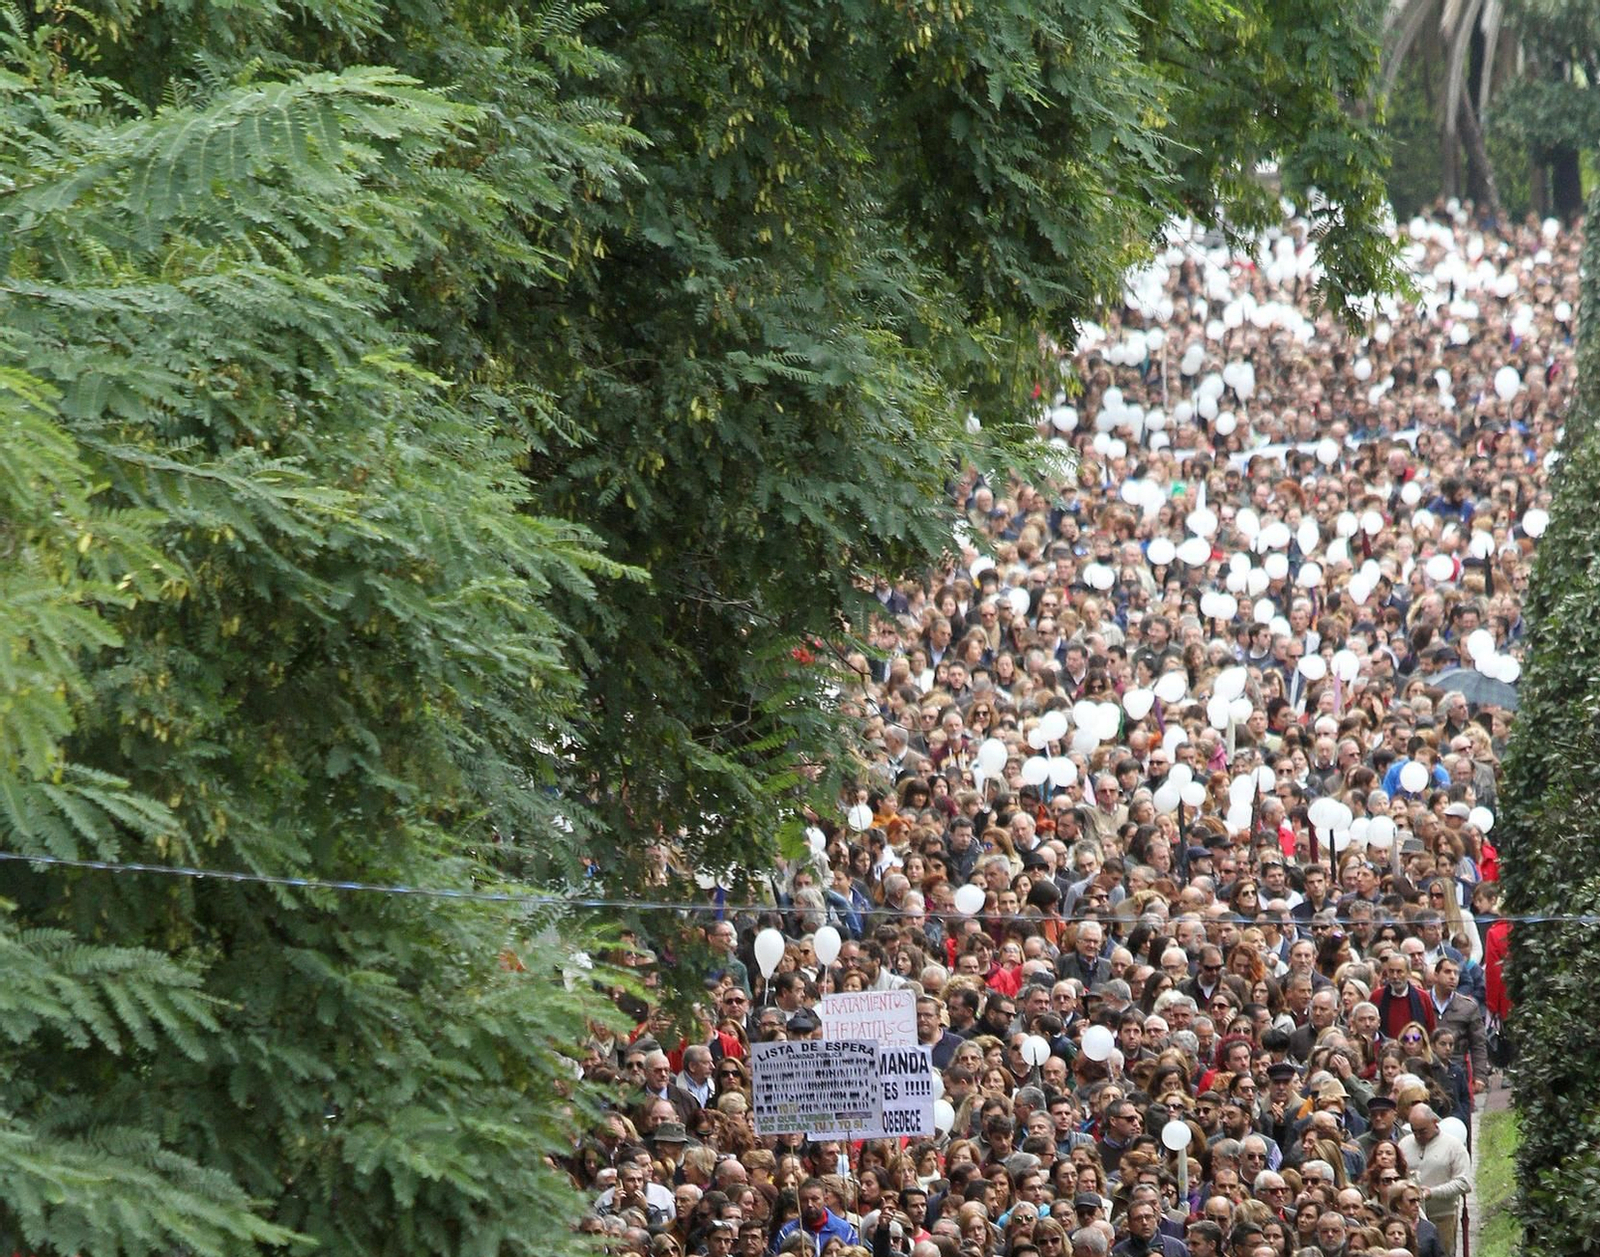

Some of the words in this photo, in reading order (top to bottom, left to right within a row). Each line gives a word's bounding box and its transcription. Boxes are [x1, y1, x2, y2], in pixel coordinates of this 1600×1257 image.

[757, 1046, 794, 1061] LISTA
[801, 1042, 818, 1052] DE
[825, 1041, 875, 1057] ESPERA
